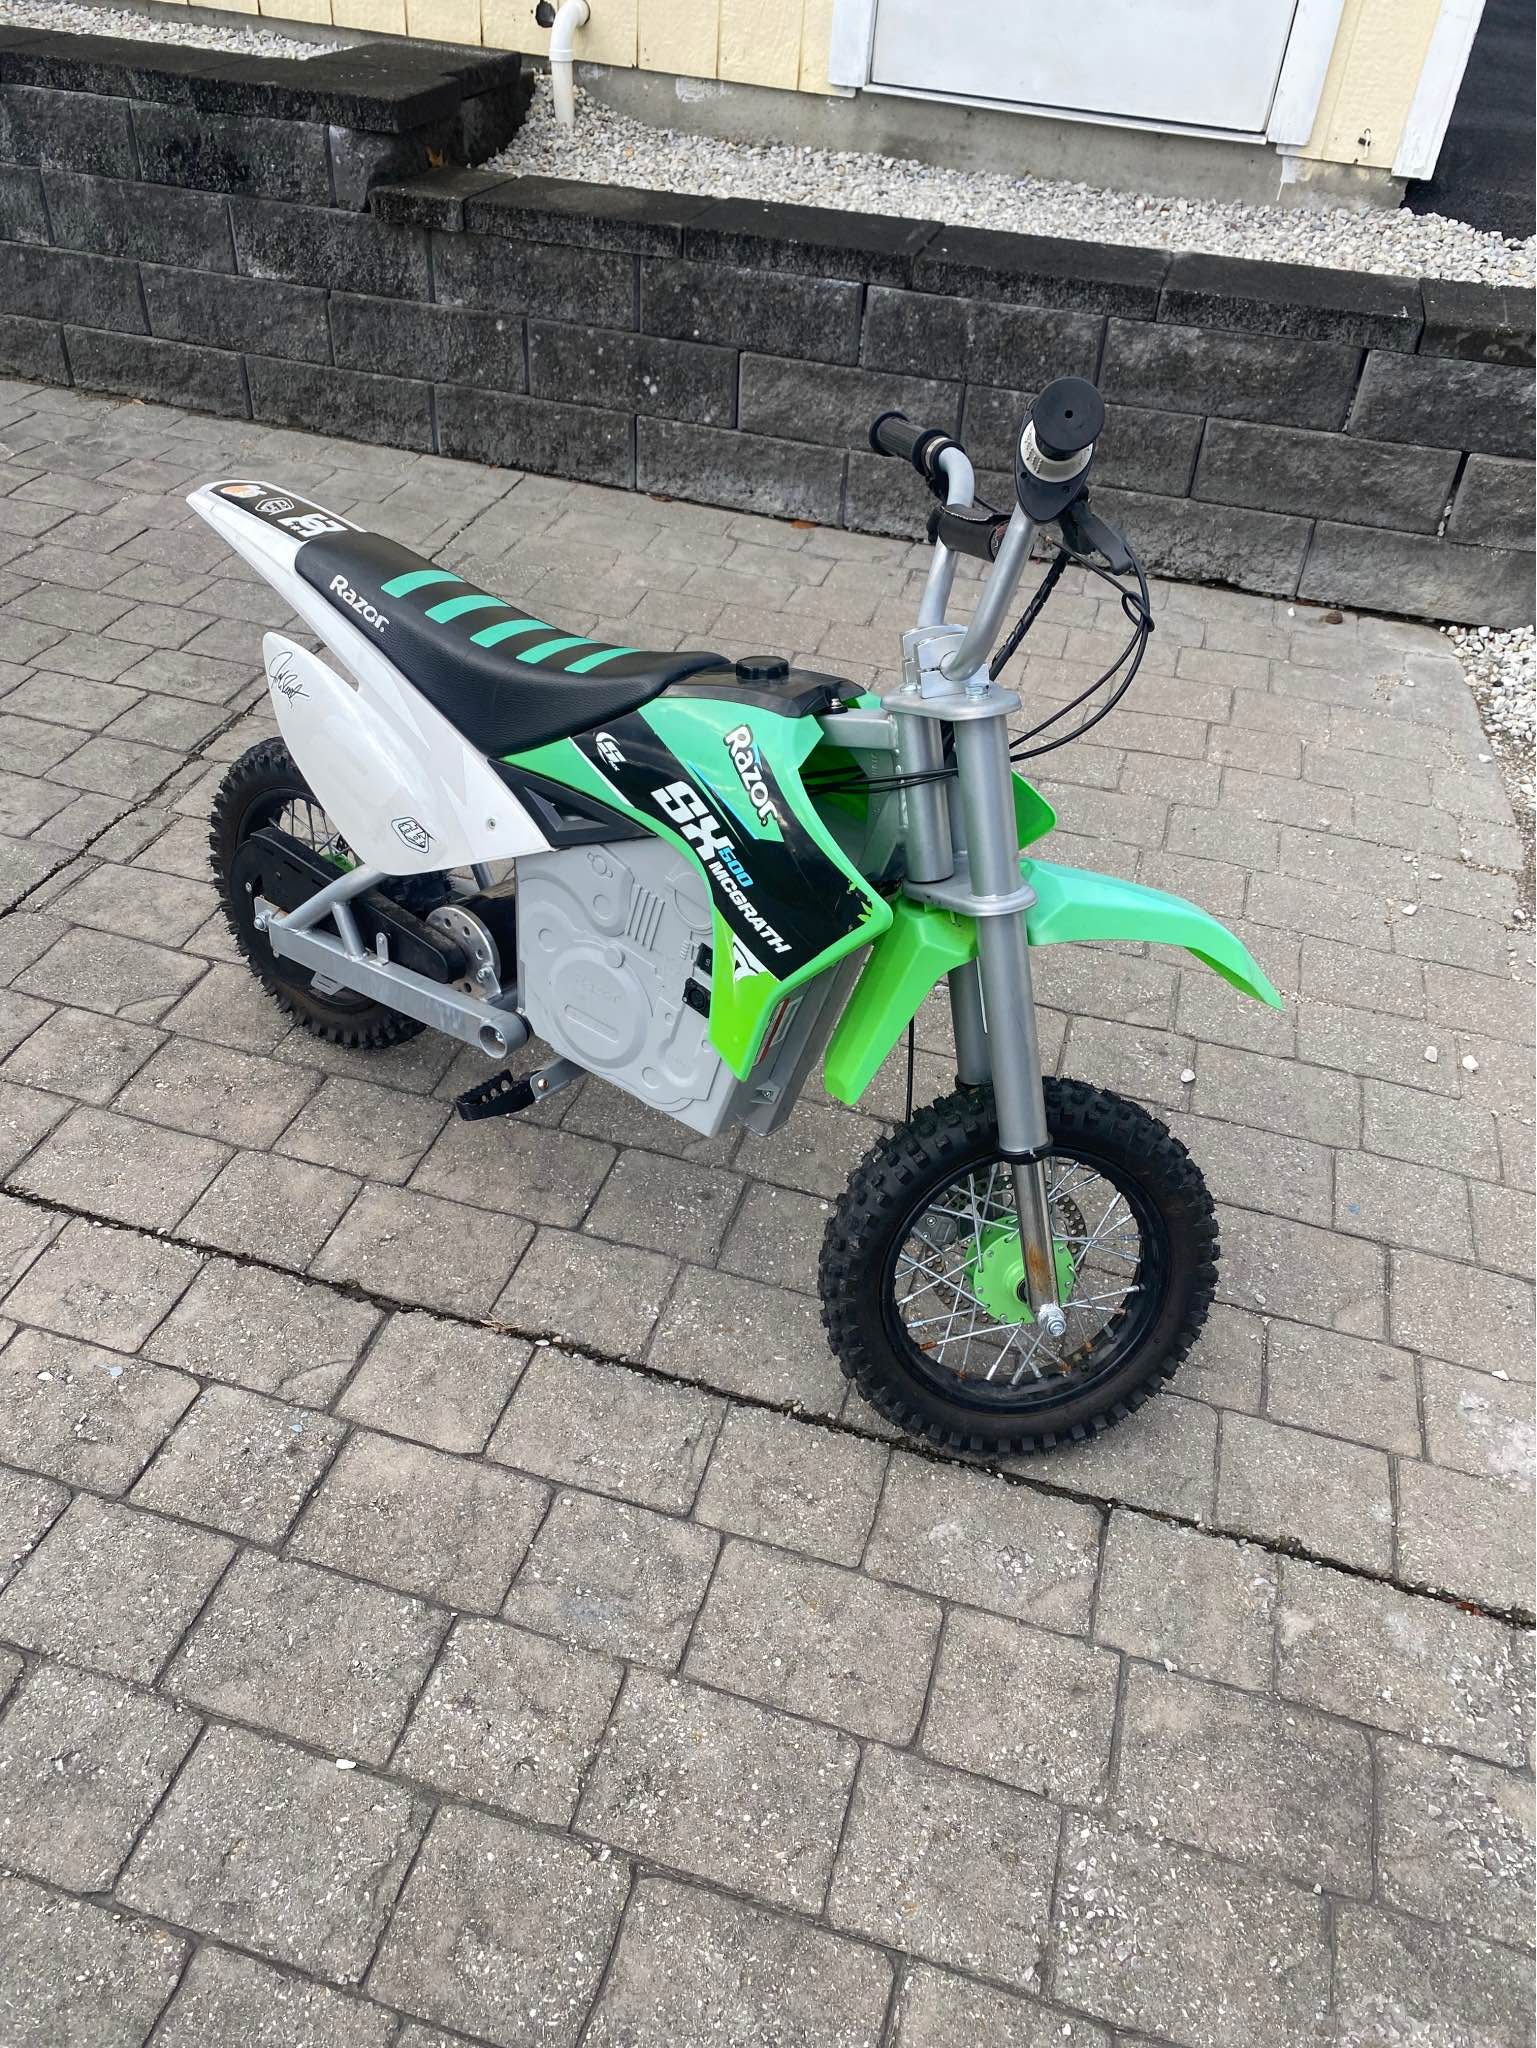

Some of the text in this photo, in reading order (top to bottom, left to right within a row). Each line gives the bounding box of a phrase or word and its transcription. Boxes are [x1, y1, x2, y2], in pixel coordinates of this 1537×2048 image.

[650, 781, 754, 888] SX 500
[708, 861, 792, 953] MCGRATH
